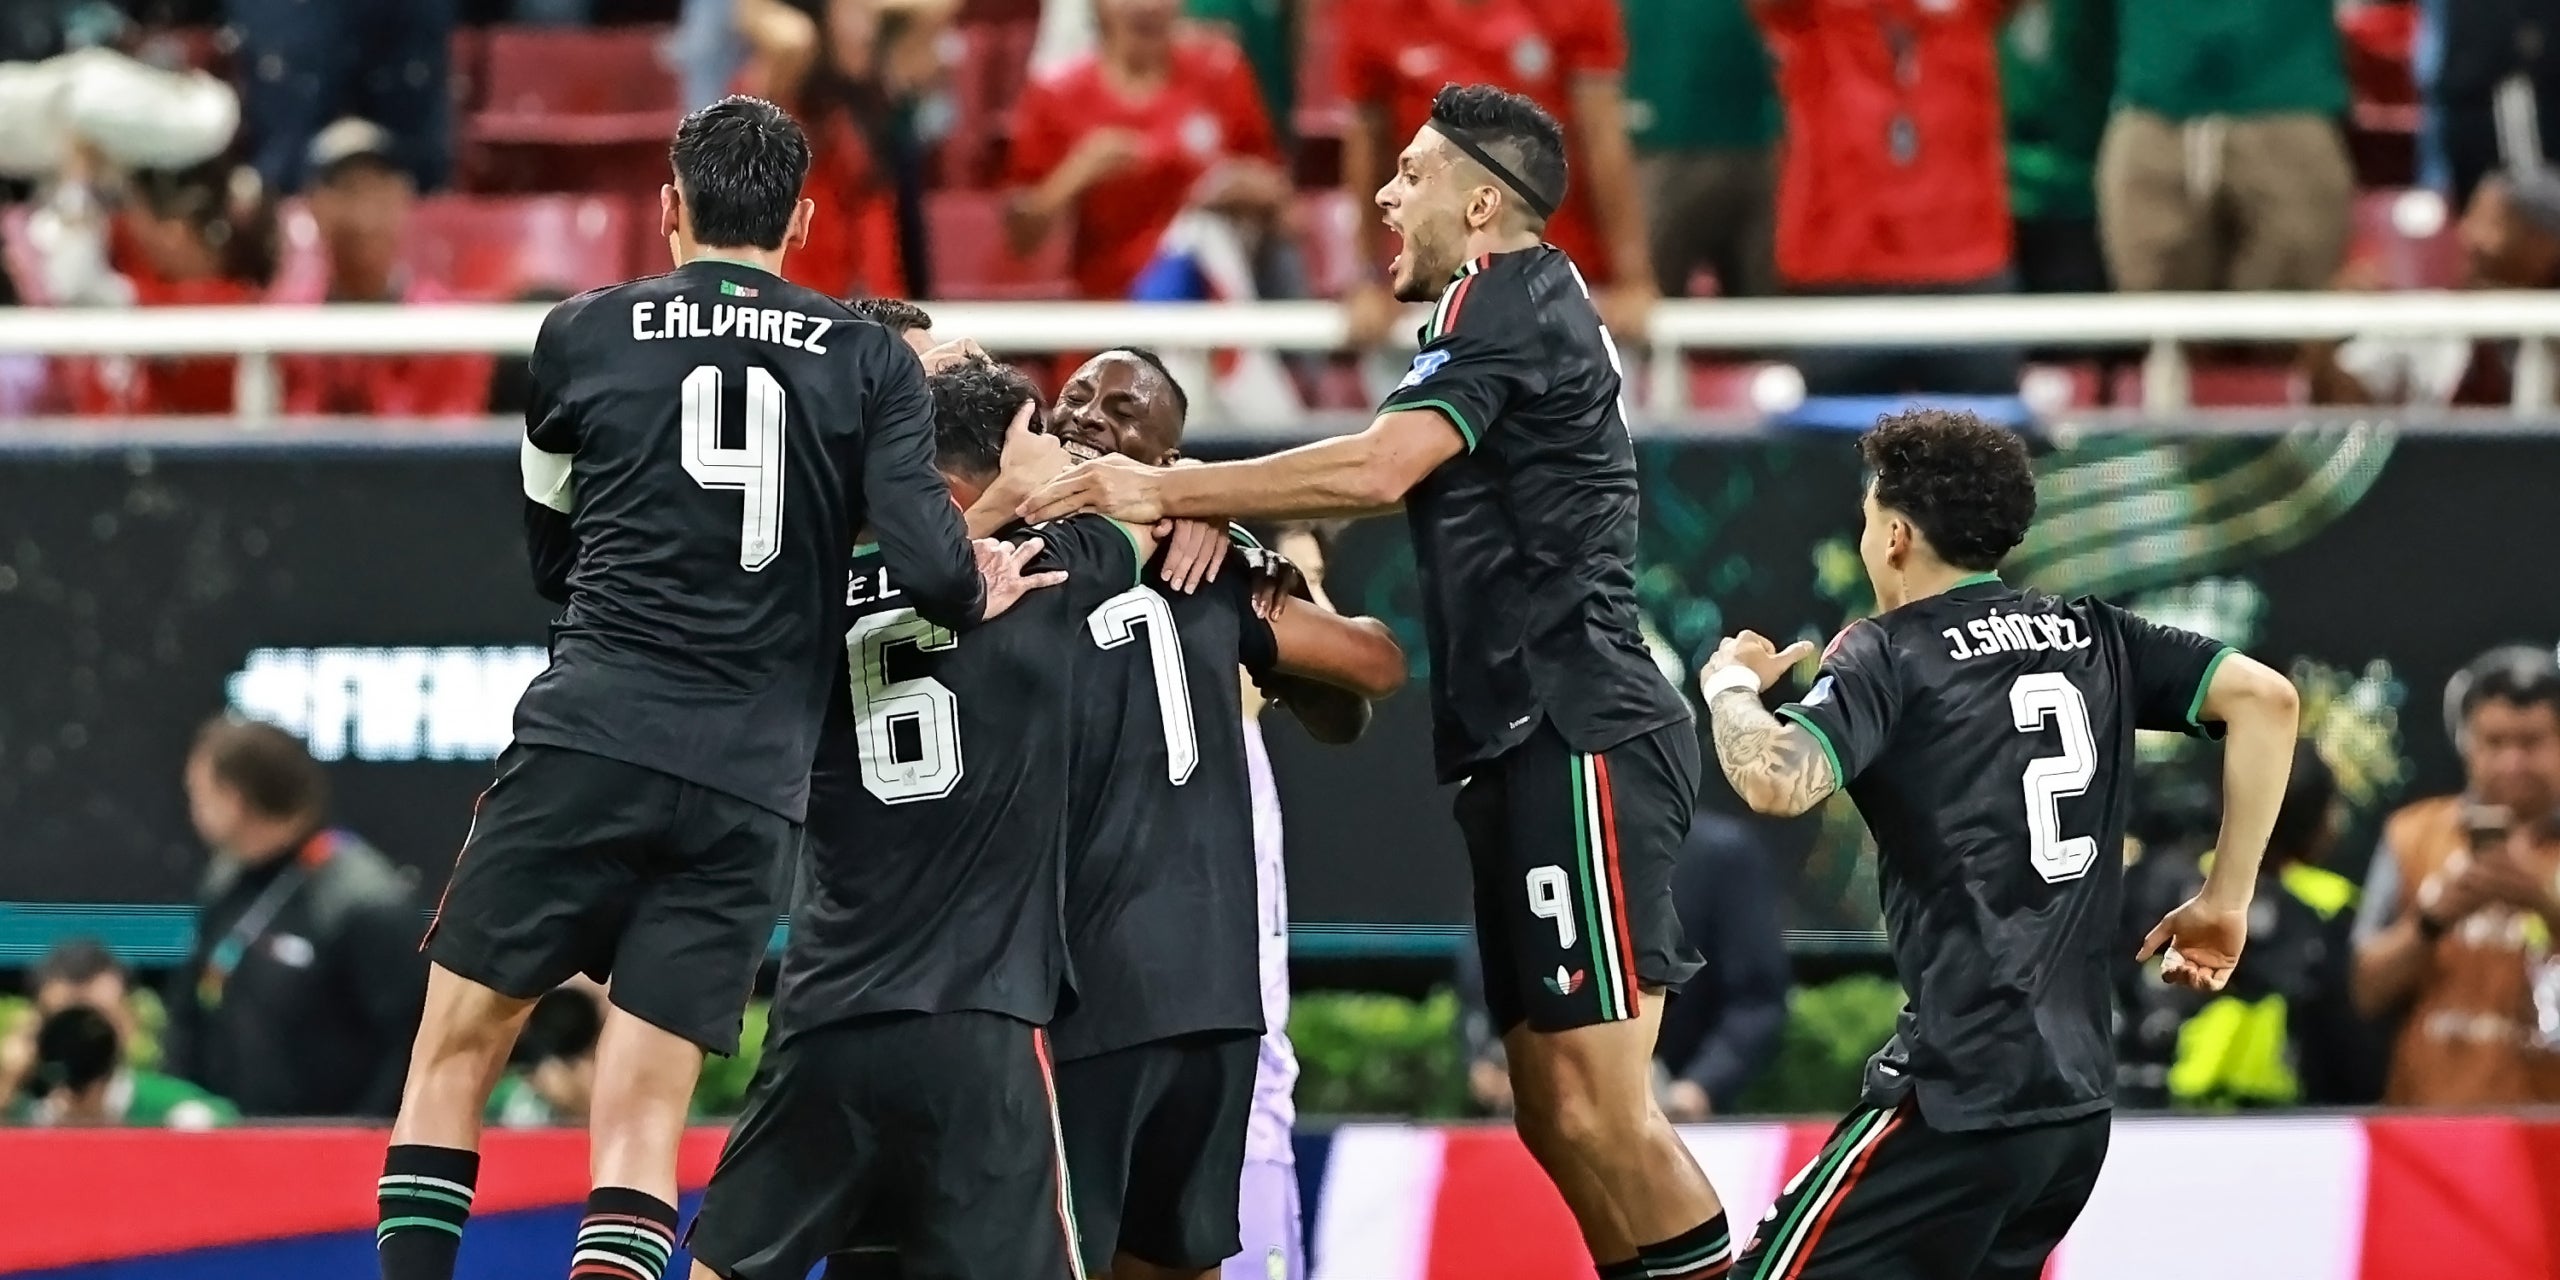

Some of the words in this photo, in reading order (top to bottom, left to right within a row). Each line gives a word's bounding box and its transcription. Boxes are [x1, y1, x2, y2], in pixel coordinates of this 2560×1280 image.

[632, 294, 833, 355] E.ÁLVAREZ
[681, 365, 787, 573] 4
[845, 565, 902, 607] E.L
[1942, 607, 2092, 661] J.SÁNCHEZ
[844, 606, 965, 806] 6
[1086, 583, 1199, 786] 7
[2008, 671, 2099, 884] 2
[1525, 864, 1577, 950] 9
